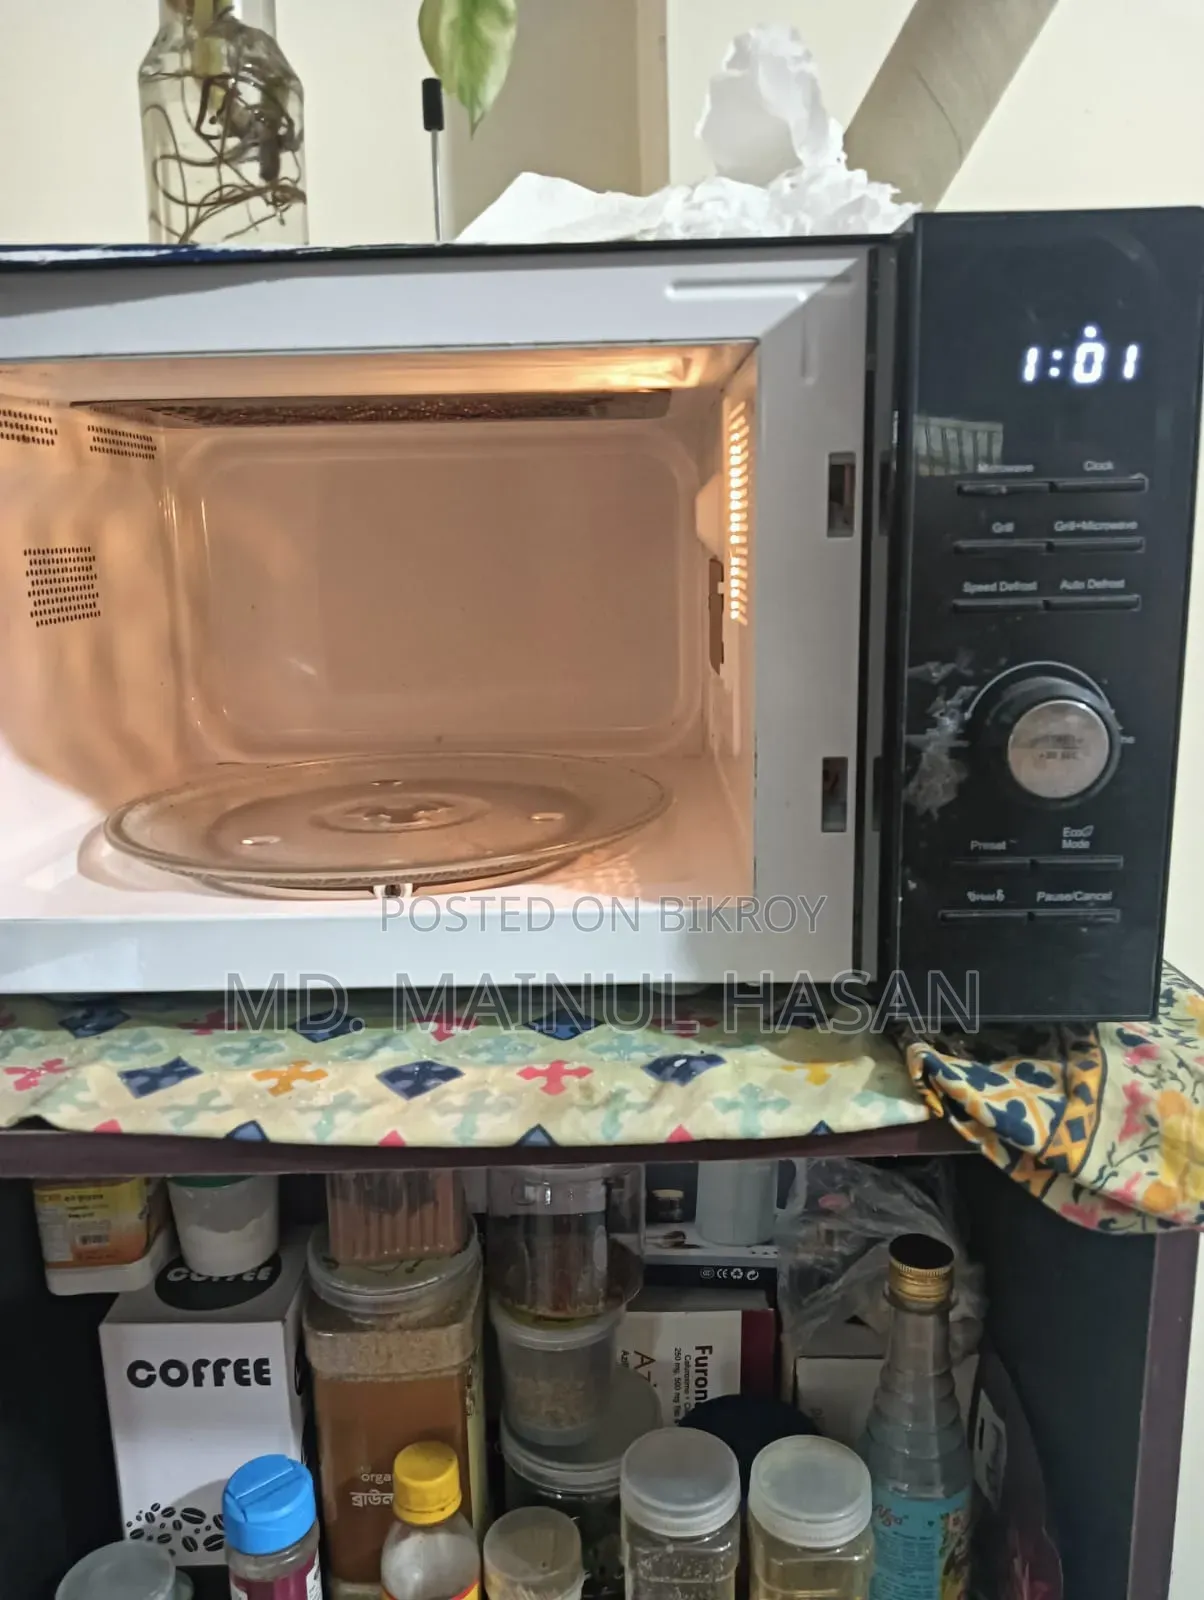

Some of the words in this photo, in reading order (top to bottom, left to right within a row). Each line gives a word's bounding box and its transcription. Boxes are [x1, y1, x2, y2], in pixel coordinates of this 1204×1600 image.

[1083, 460, 1114, 471] Clock
[992, 522, 1014, 533] Grill
[1060, 580, 1085, 590] Auto
[970, 840, 1006, 851] Preset
[1062, 840, 1090, 849] Mode
[1036, 890, 1113, 902] Pause/Cancel
[674, 1347, 682, 1361] 250
[126, 1357, 272, 1388] COFFEE
[674, 1377, 682, 1391] 500
